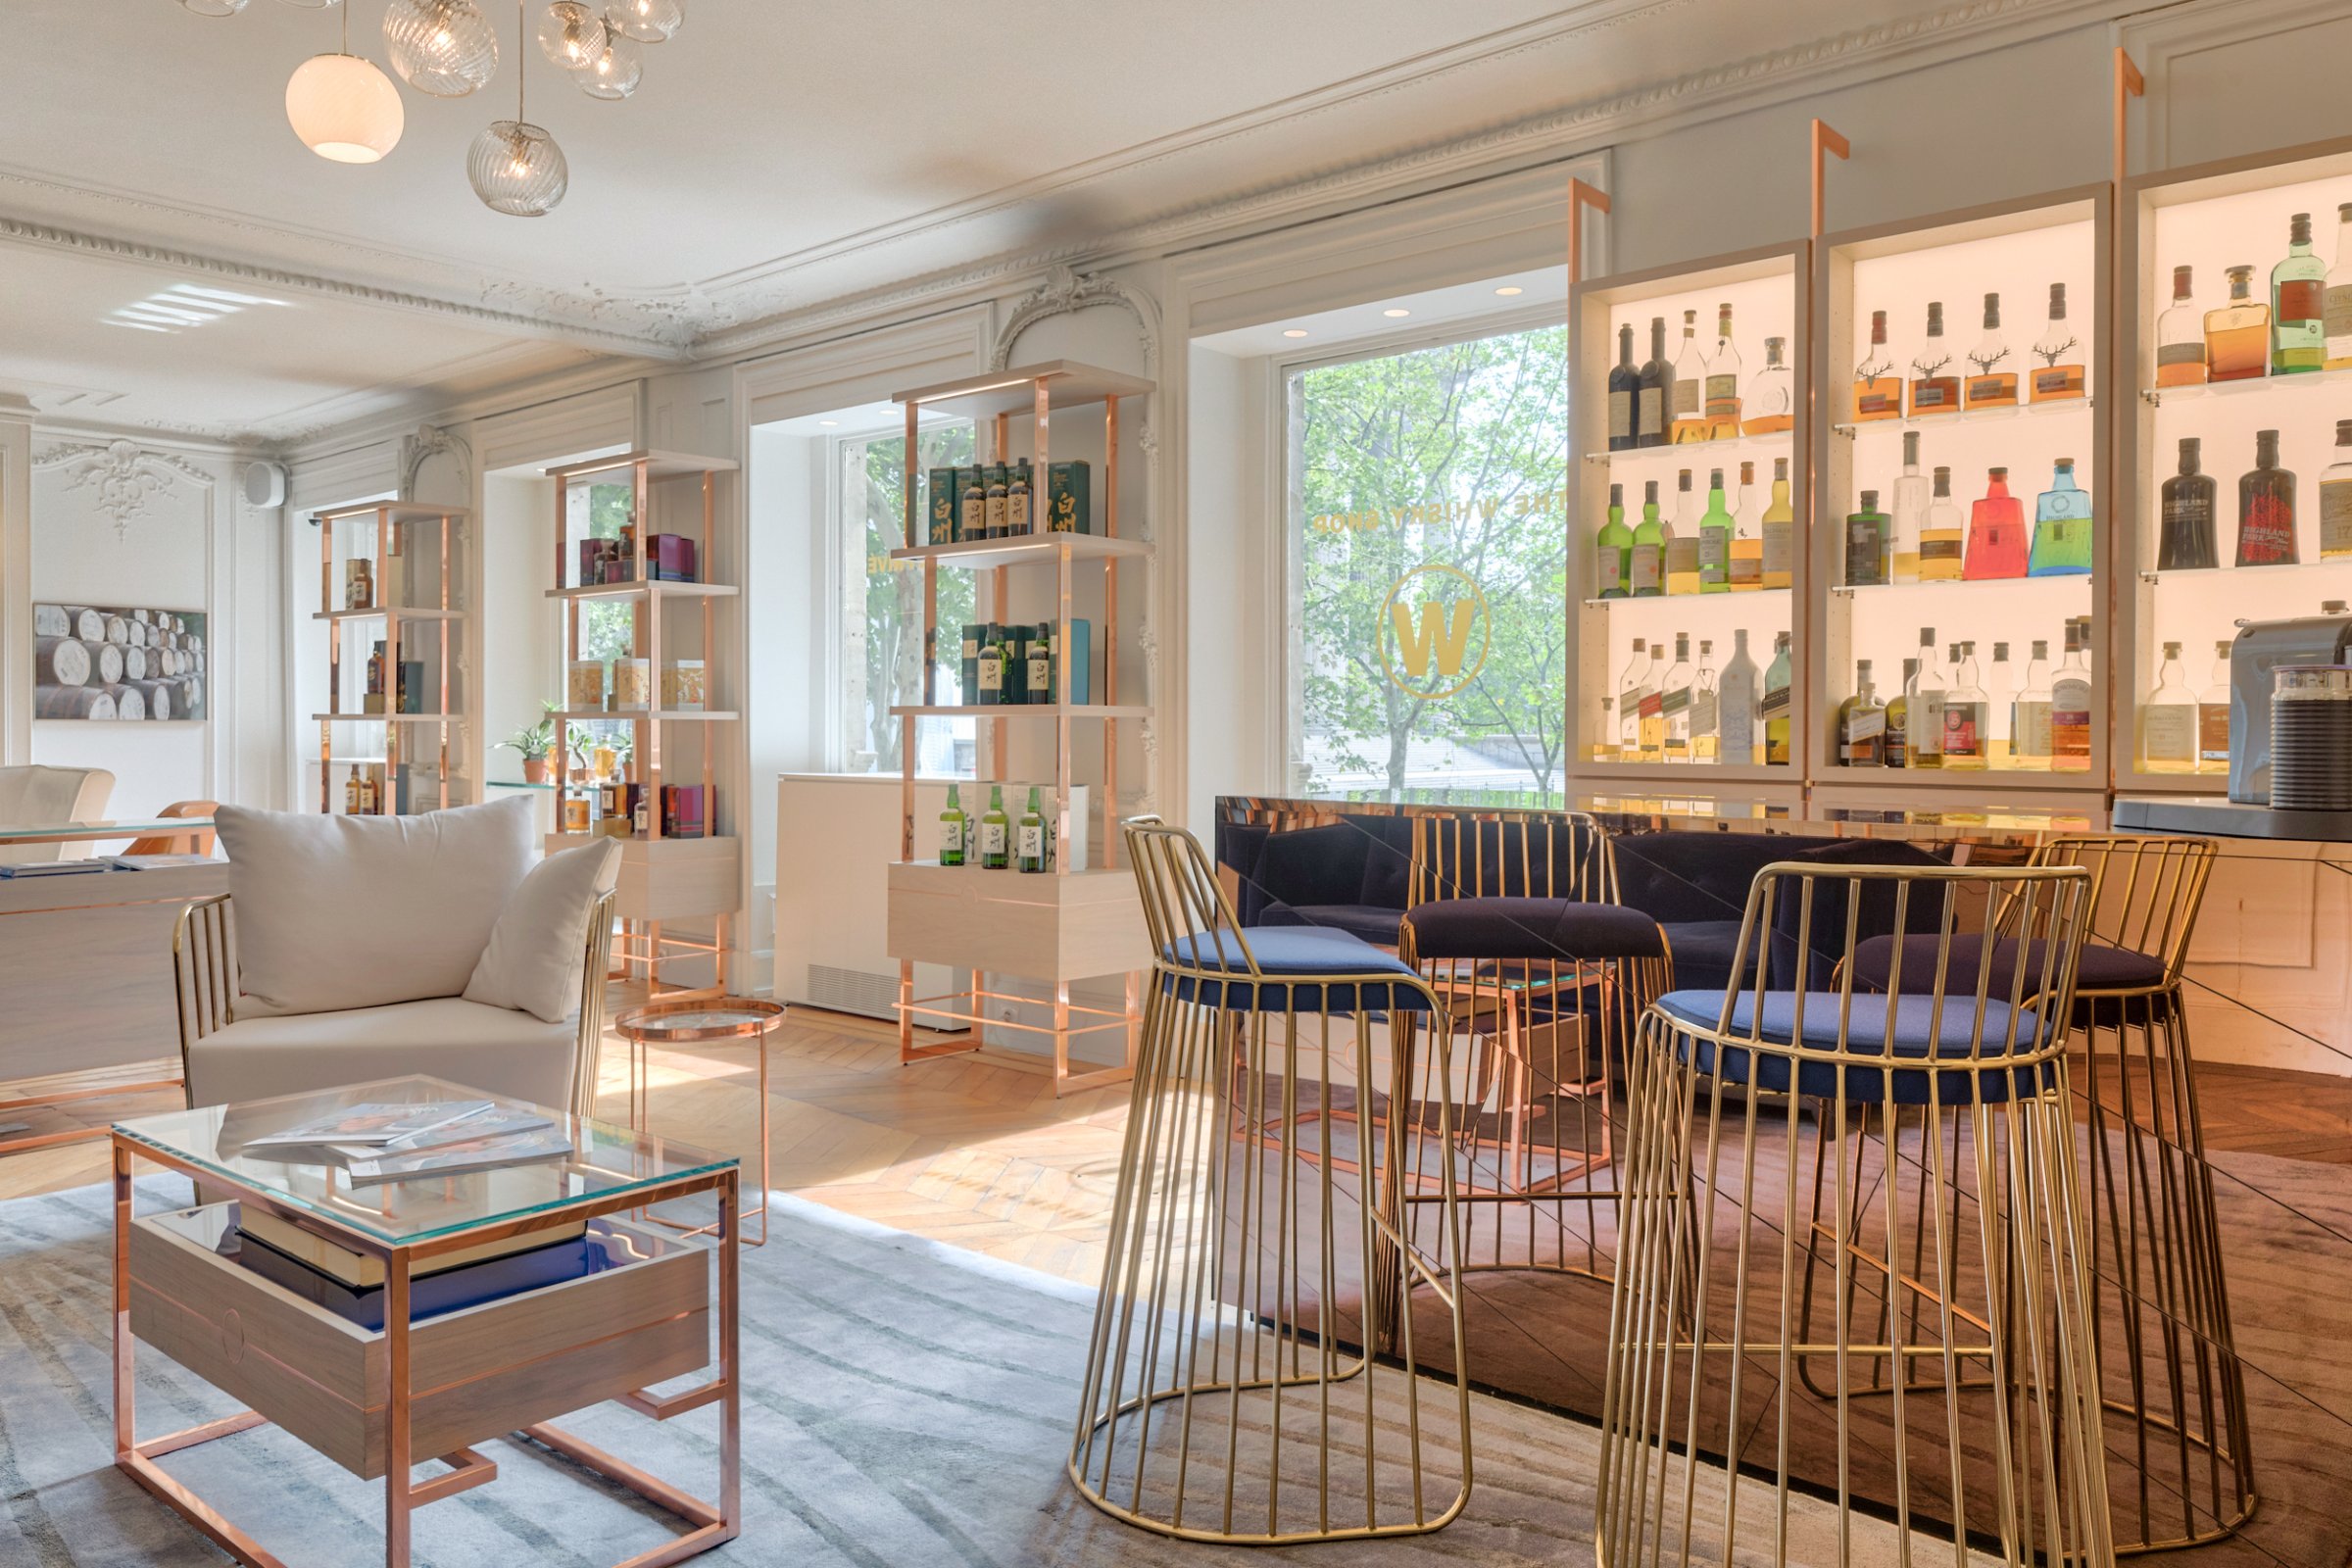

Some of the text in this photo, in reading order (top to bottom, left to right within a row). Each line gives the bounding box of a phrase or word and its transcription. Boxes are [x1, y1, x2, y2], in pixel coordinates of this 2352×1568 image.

[932, 498, 953, 544] 白州
[2243, 526, 2290, 538] HIGHLAND
[1390, 599, 1476, 677] W
